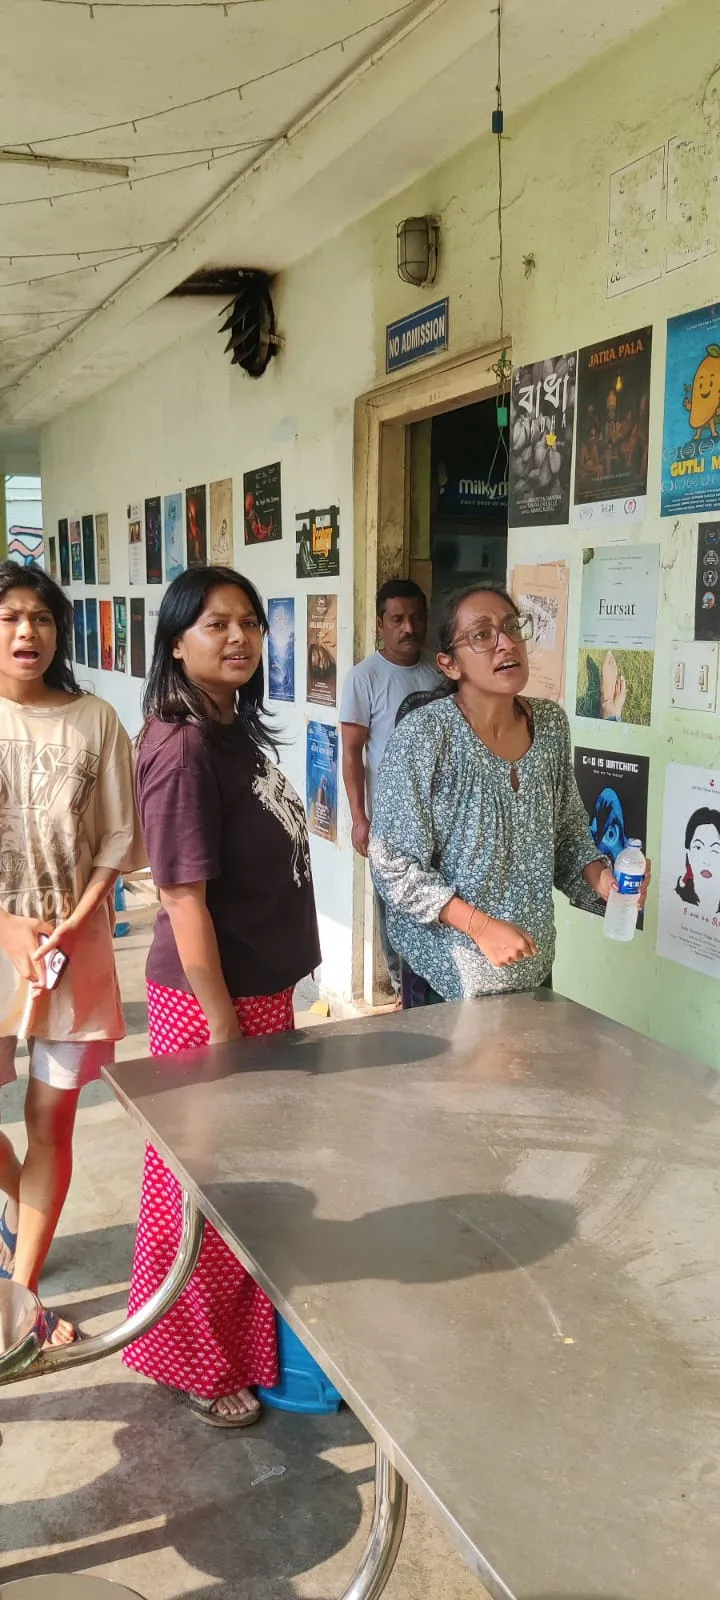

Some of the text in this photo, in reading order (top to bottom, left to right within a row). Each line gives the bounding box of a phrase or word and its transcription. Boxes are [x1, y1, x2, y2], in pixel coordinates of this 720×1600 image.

[388, 315, 445, 360] NO ADMISSION
[588, 339, 644, 368] JATRA PALA
[518, 373, 570, 418] বাধা
[670, 457, 705, 477] GUTLI
[598, 598, 636, 616] Fursat
[597, 757, 604, 768] IS
[605, 759, 639, 773] WATCHING
